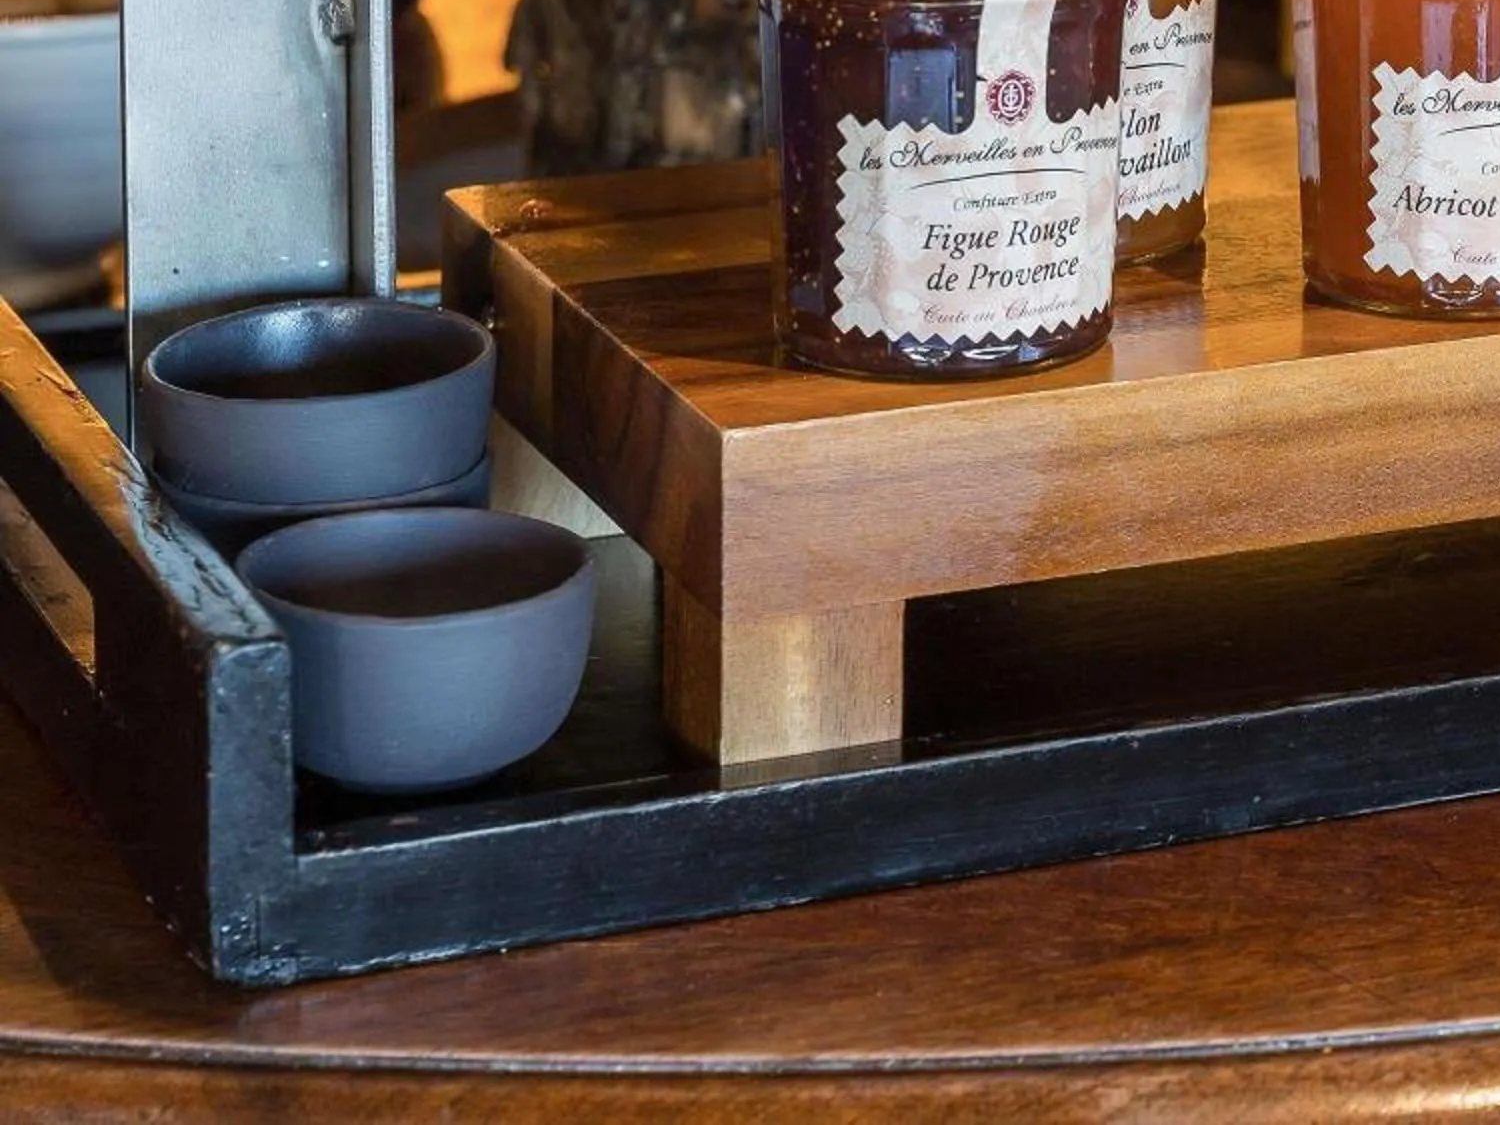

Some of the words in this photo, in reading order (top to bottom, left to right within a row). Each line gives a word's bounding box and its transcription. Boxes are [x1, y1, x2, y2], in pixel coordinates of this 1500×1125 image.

[1129, 41, 1151, 56] en
[1392, 92, 1416, 116] les
[1120, 108, 1161, 138] lon
[859, 146, 882, 171] les
[889, 134, 1018, 168] Merveilles
[1023, 144, 1044, 158] en
[1119, 137, 1191, 177] vaillon
[953, 193, 1019, 214] Confiture
[1021, 189, 1057, 206] Extra
[1393, 183, 1497, 218] Abricot
[922, 224, 999, 259] Figue
[1007, 216, 1081, 253] Rouge
[927, 264, 963, 293] de
[967, 256, 1080, 291] Provence
